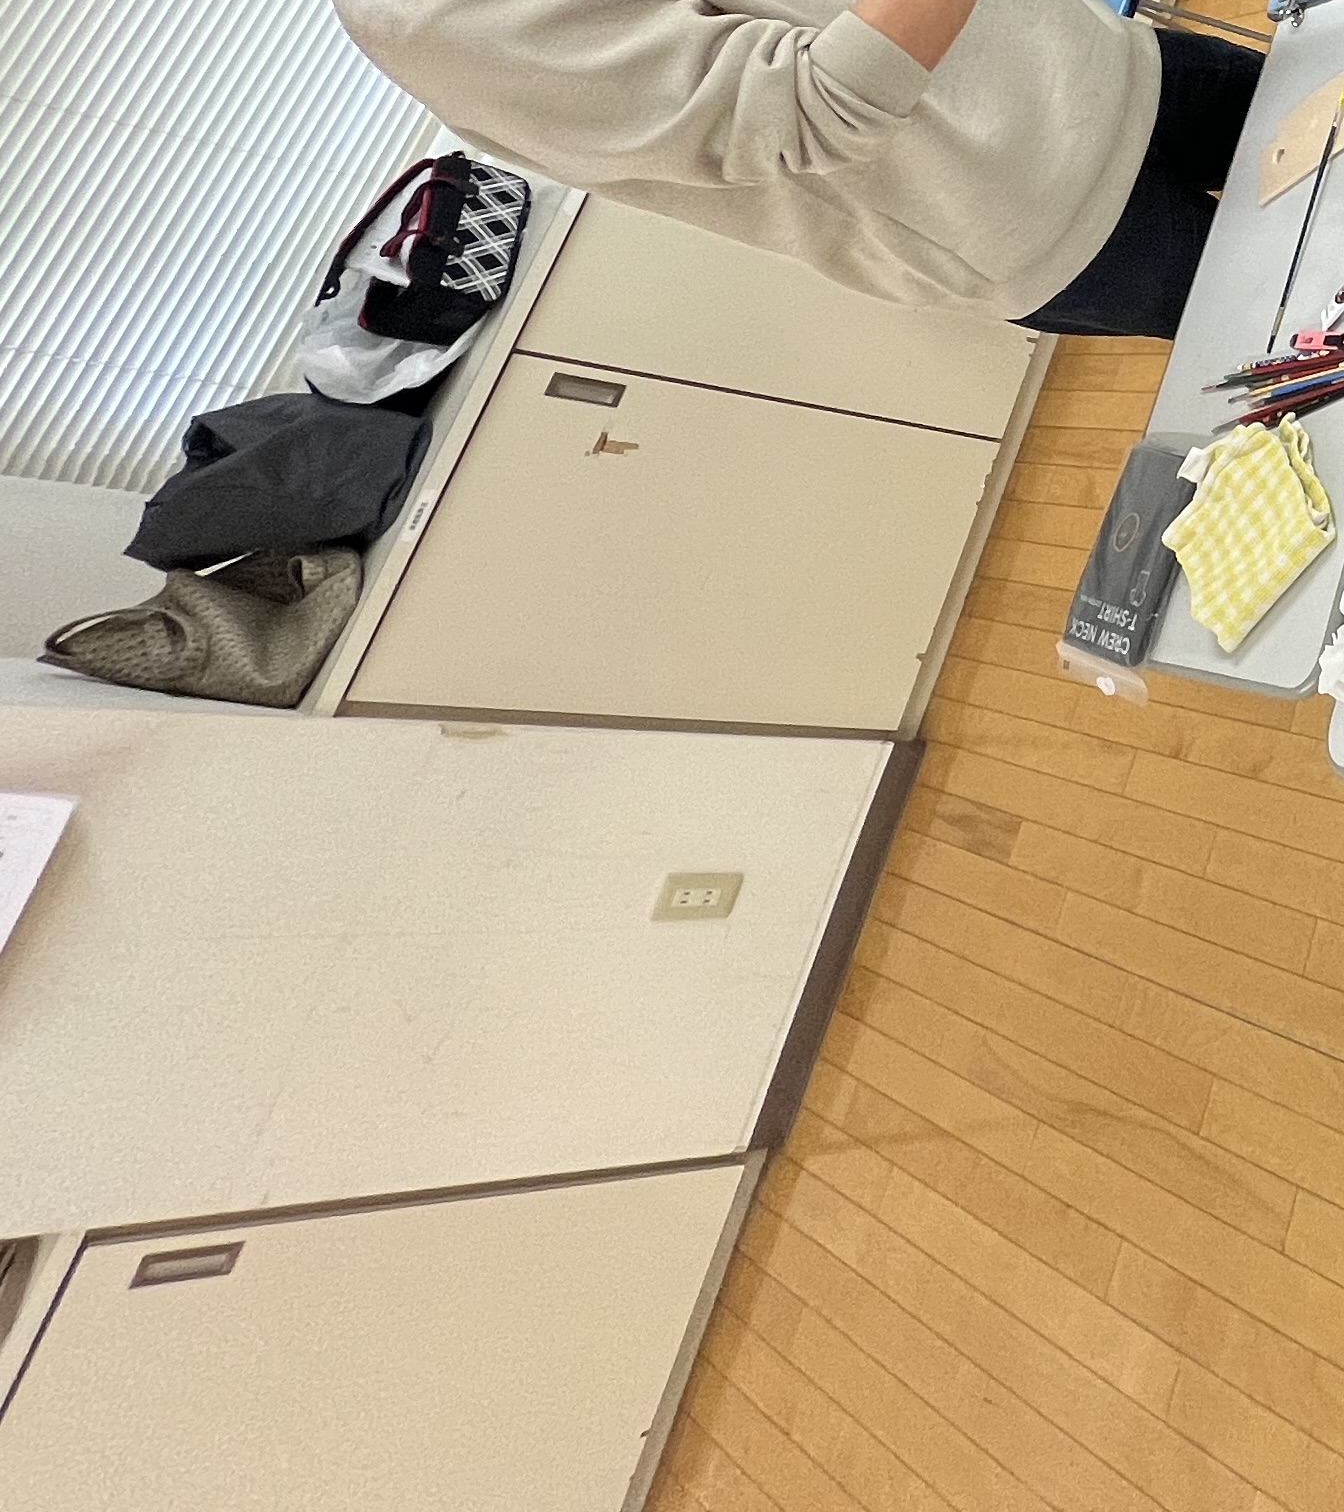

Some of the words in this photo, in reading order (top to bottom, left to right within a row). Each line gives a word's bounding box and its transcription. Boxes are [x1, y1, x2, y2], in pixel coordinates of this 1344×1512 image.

[1097, 602, 1137, 630] T-SHIRT
[1069, 618, 1097, 643] NECK
[1098, 629, 1130, 654] CREW
